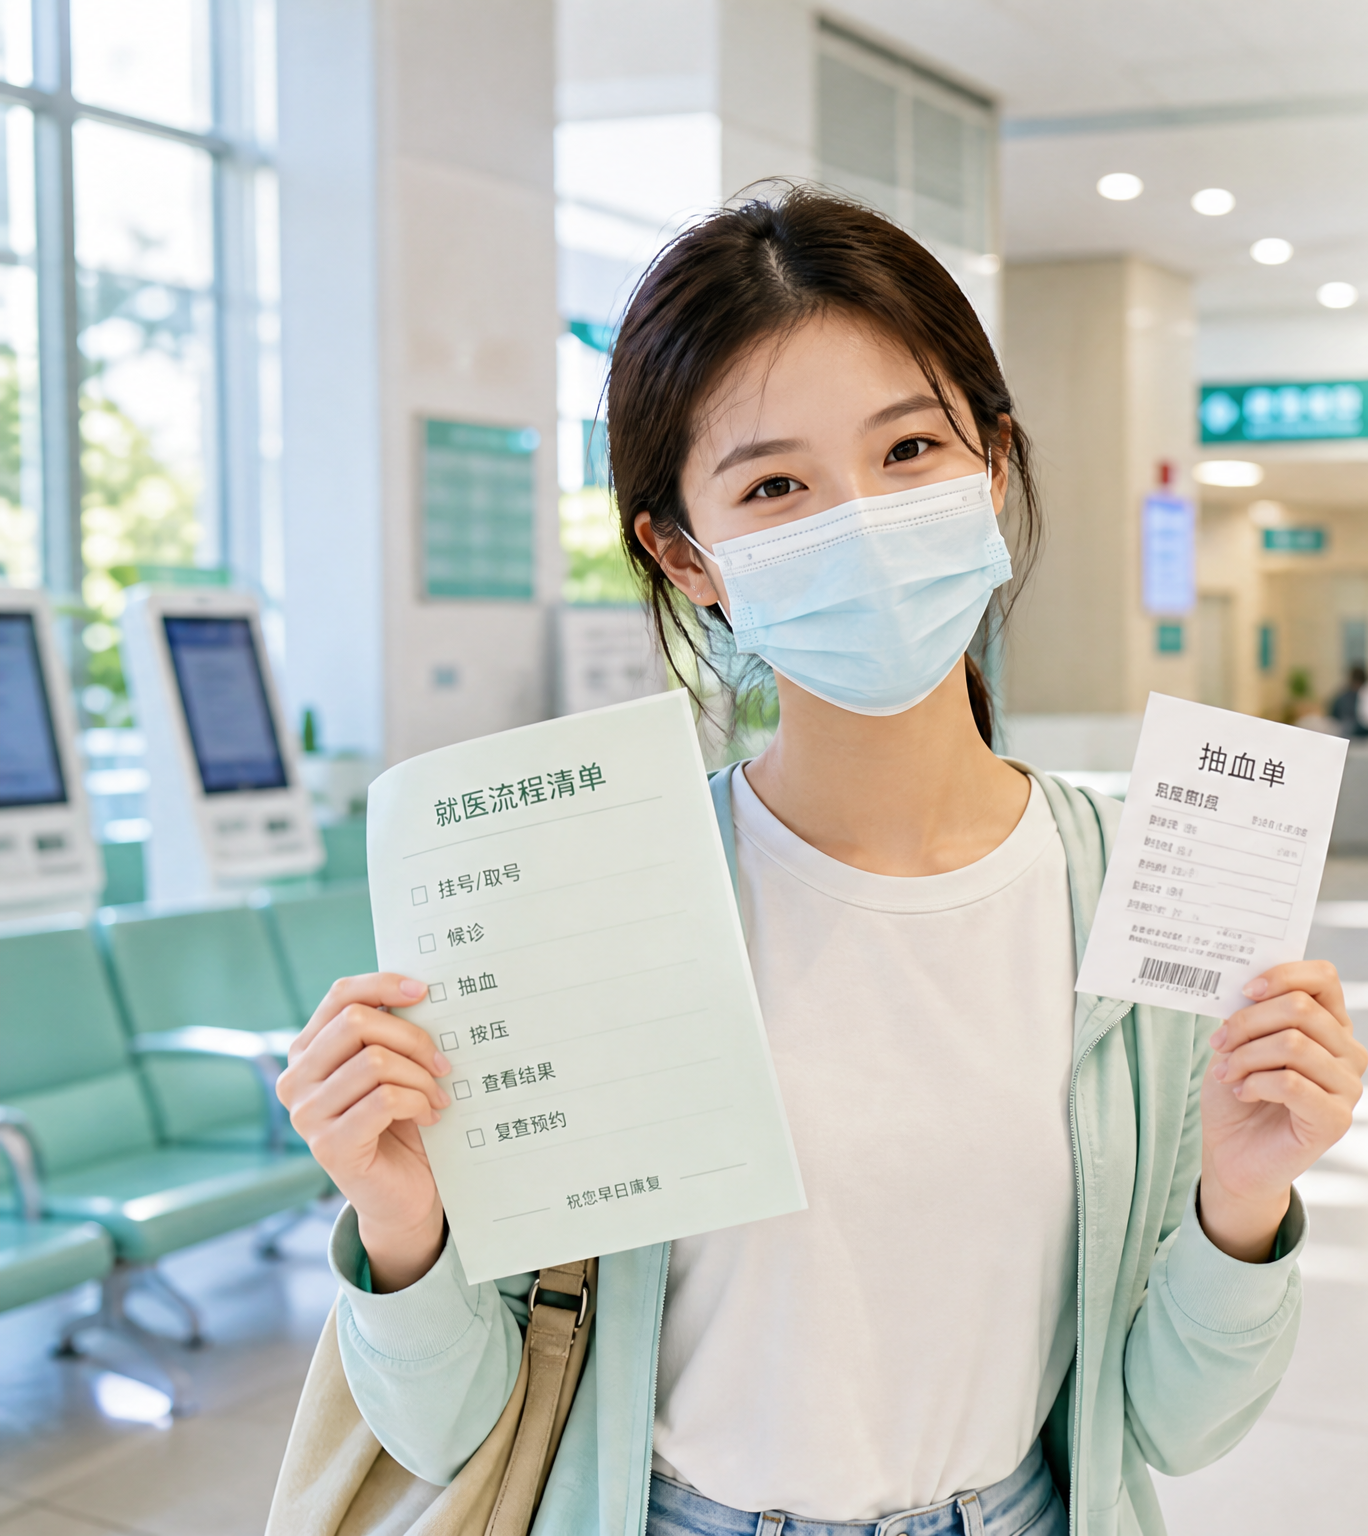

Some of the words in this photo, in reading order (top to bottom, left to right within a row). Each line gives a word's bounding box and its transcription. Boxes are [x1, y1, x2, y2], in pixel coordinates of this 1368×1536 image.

[1198, 742, 1285, 788] 抽血单
[433, 761, 607, 827] 就医流程清单
[437, 862, 521, 900] 挂号/取号
[446, 922, 485, 948] 候诊
[457, 971, 499, 997] 抽血
[469, 1019, 510, 1046] 按压
[481, 1061, 557, 1094] 查看结果
[494, 1110, 567, 1143] 复查预约
